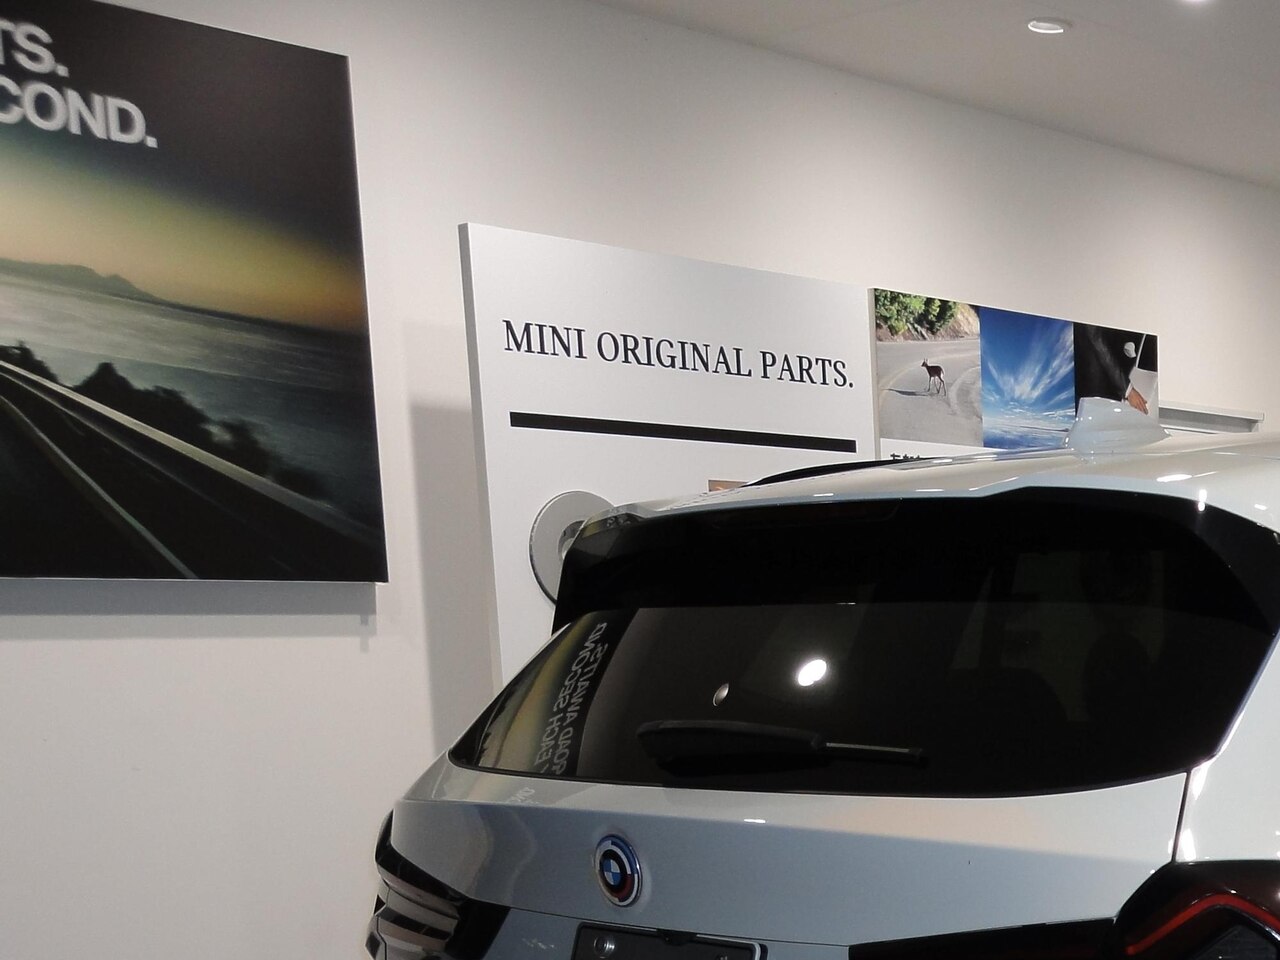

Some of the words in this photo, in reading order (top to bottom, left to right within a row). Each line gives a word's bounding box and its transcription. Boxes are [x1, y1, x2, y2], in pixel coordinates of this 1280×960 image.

[503, 319, 588, 359] MINI
[597, 332, 752, 378] ORIGINAL
[759, 350, 855, 388] PARTS.
